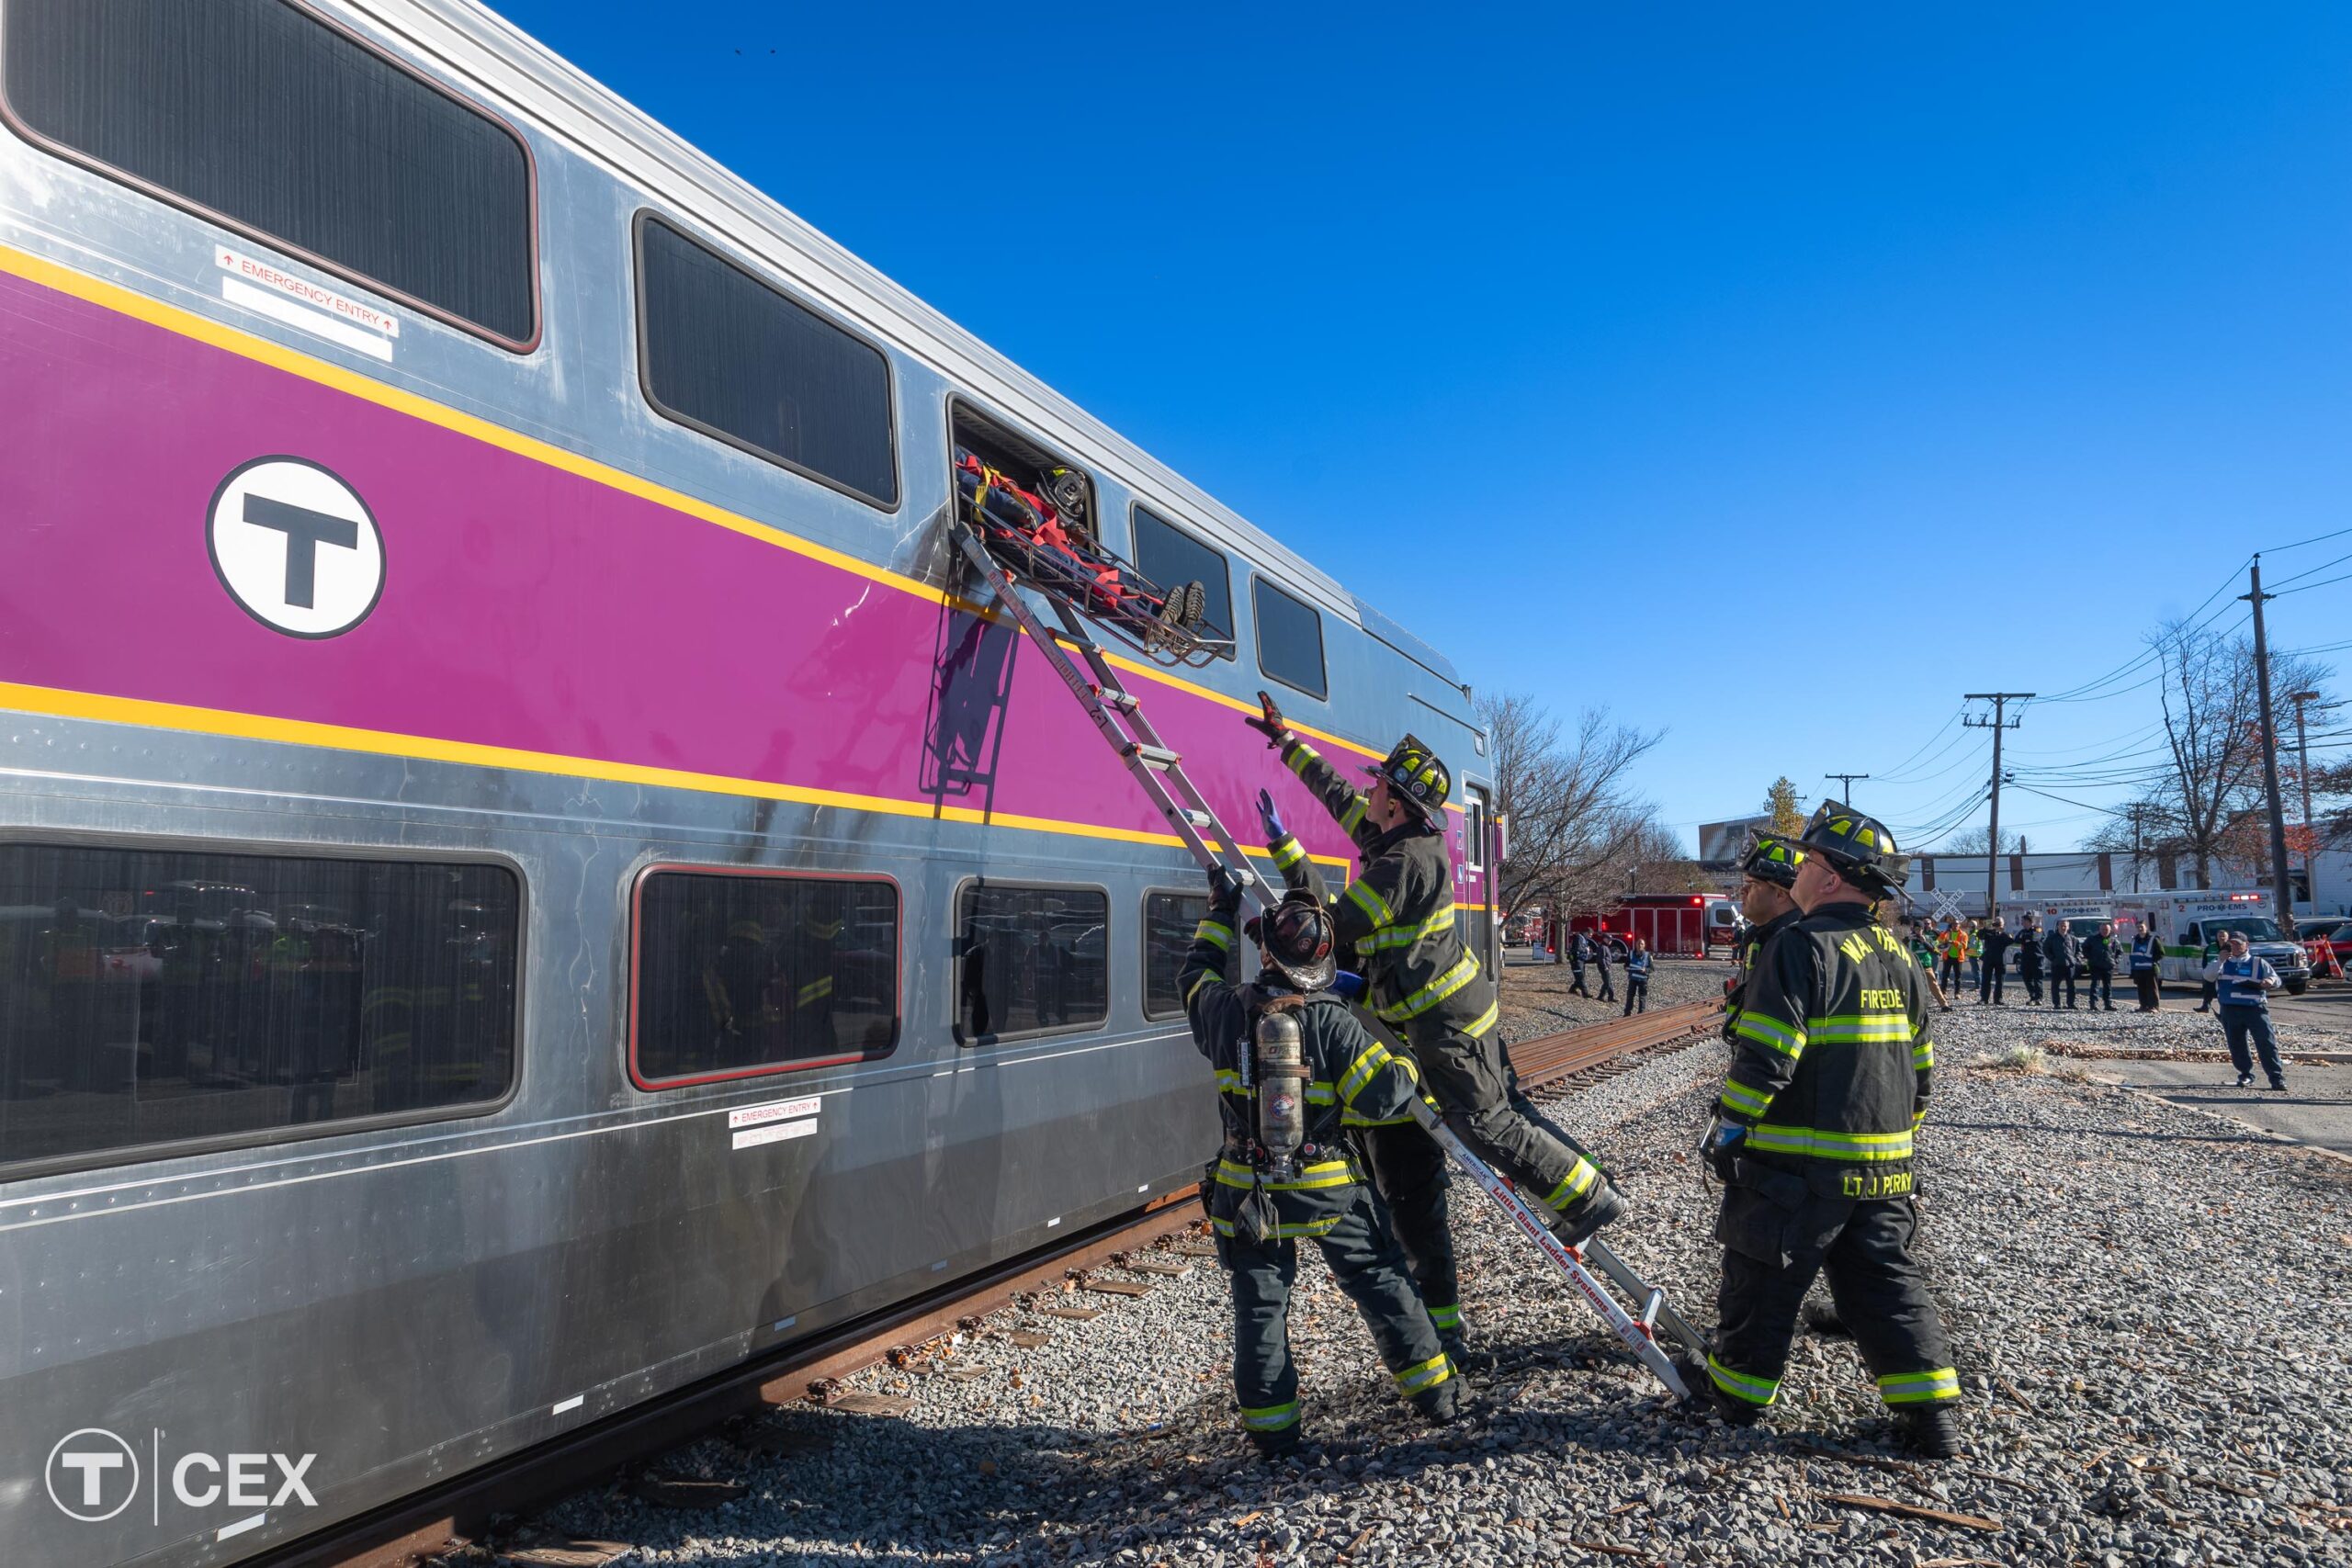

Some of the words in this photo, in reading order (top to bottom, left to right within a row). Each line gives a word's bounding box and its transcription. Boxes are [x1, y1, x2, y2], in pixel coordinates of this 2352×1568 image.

[242, 260, 333, 306] EMERGENCY
[336, 299, 379, 325] ENTRY
[243, 492, 358, 610] T
[1932, 889, 1946, 905] RAIL
[1934, 890, 1962, 919] CROSSING
[741, 1106, 786, 1122] EMERGENCY
[788, 1102, 810, 1114] ENTRY
[1843, 1176, 1863, 1196] LT
[1867, 1177, 1878, 1195] J
[1491, 1186, 1517, 1213] Little
[1516, 1211, 1541, 1237] Giant
[1539, 1236, 1571, 1271] Ladder
[1570, 1269, 1610, 1314] Systems
